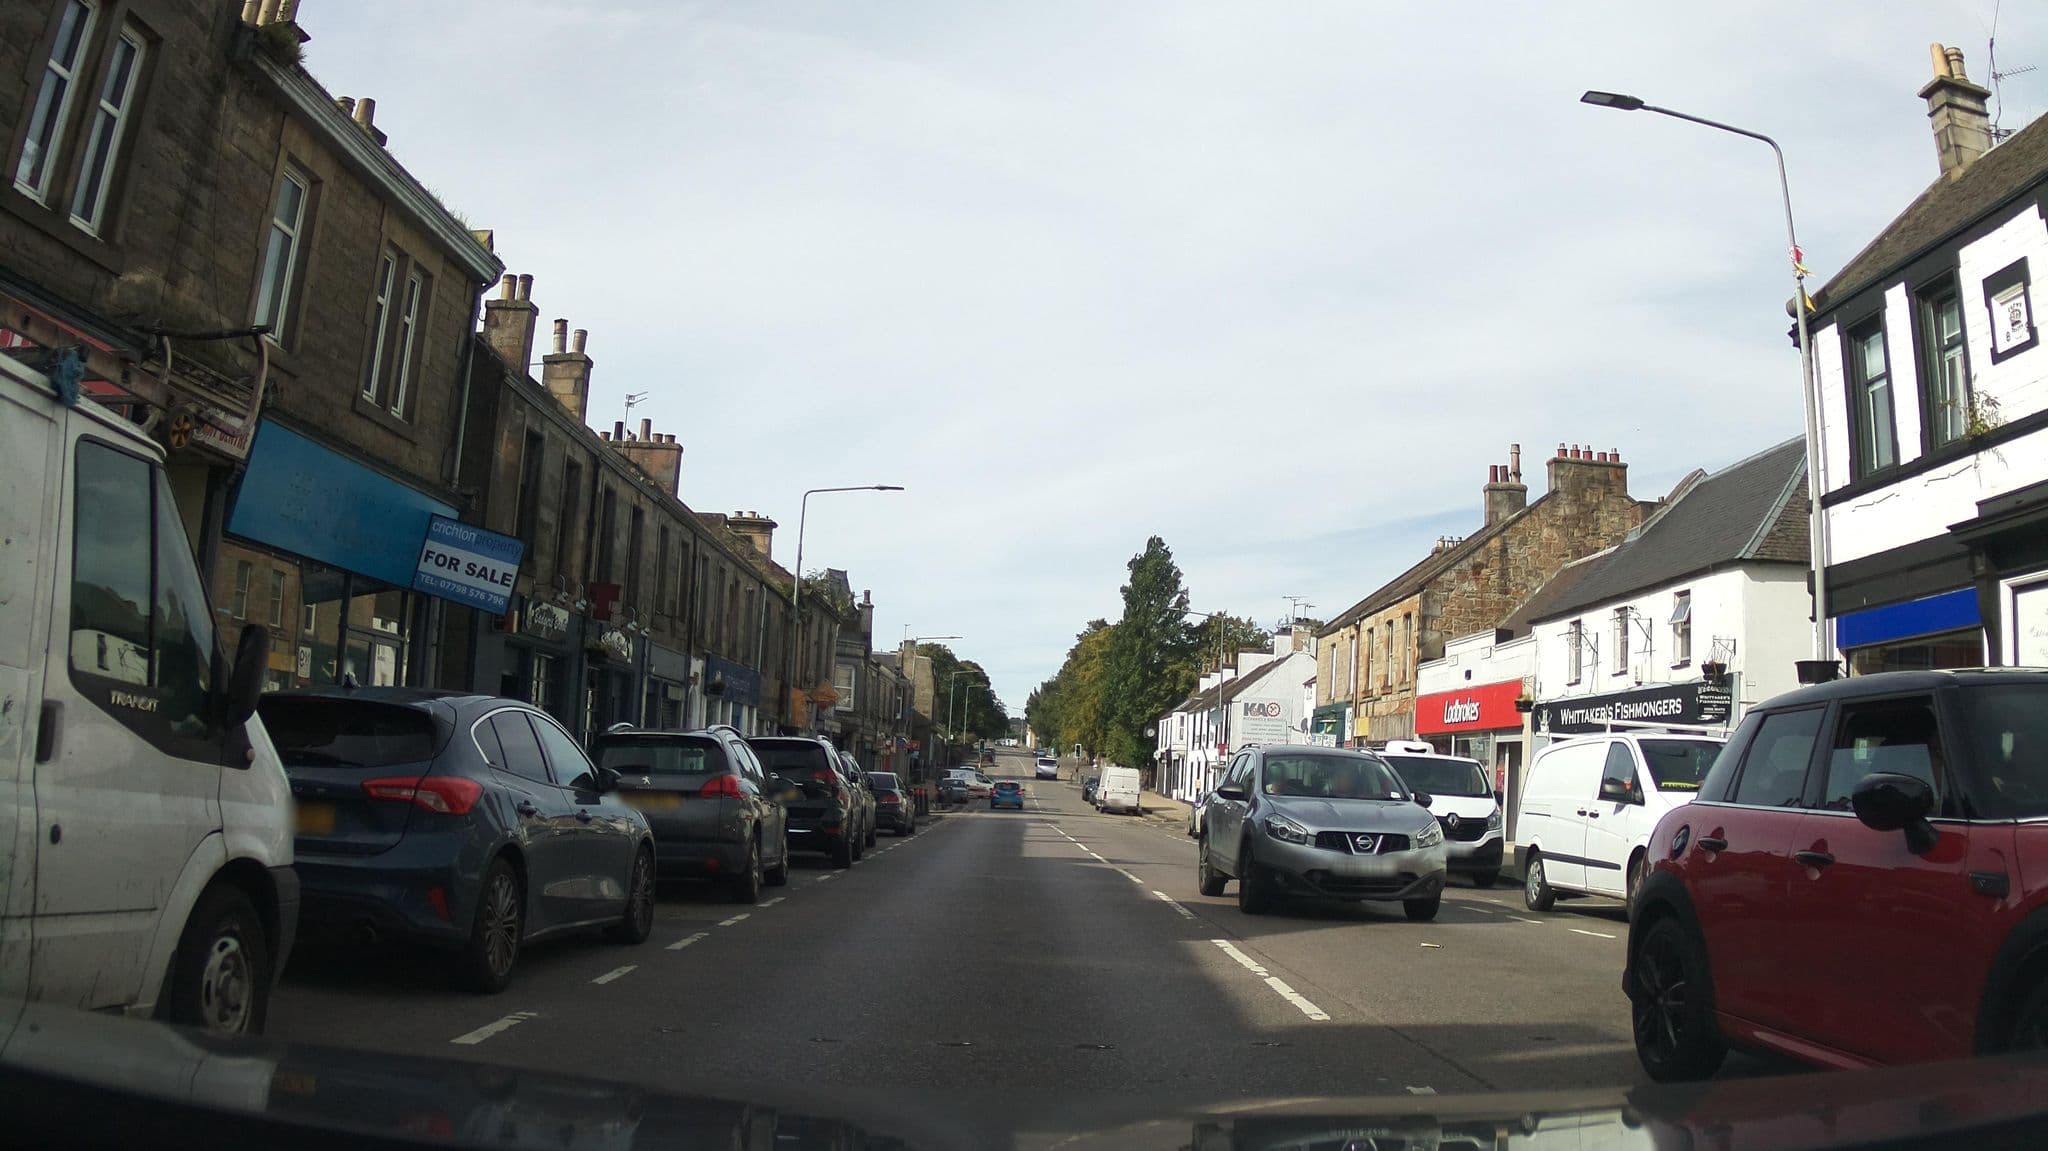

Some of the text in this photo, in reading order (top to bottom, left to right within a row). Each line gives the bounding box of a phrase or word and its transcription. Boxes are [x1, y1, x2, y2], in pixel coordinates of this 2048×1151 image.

[424, 549, 513, 588] FOR SALE
[111, 690, 159, 712] TRANSIT
[1444, 697, 1480, 724] Ladbrokes
[1615, 698, 1682, 720] FISHMONGERS
